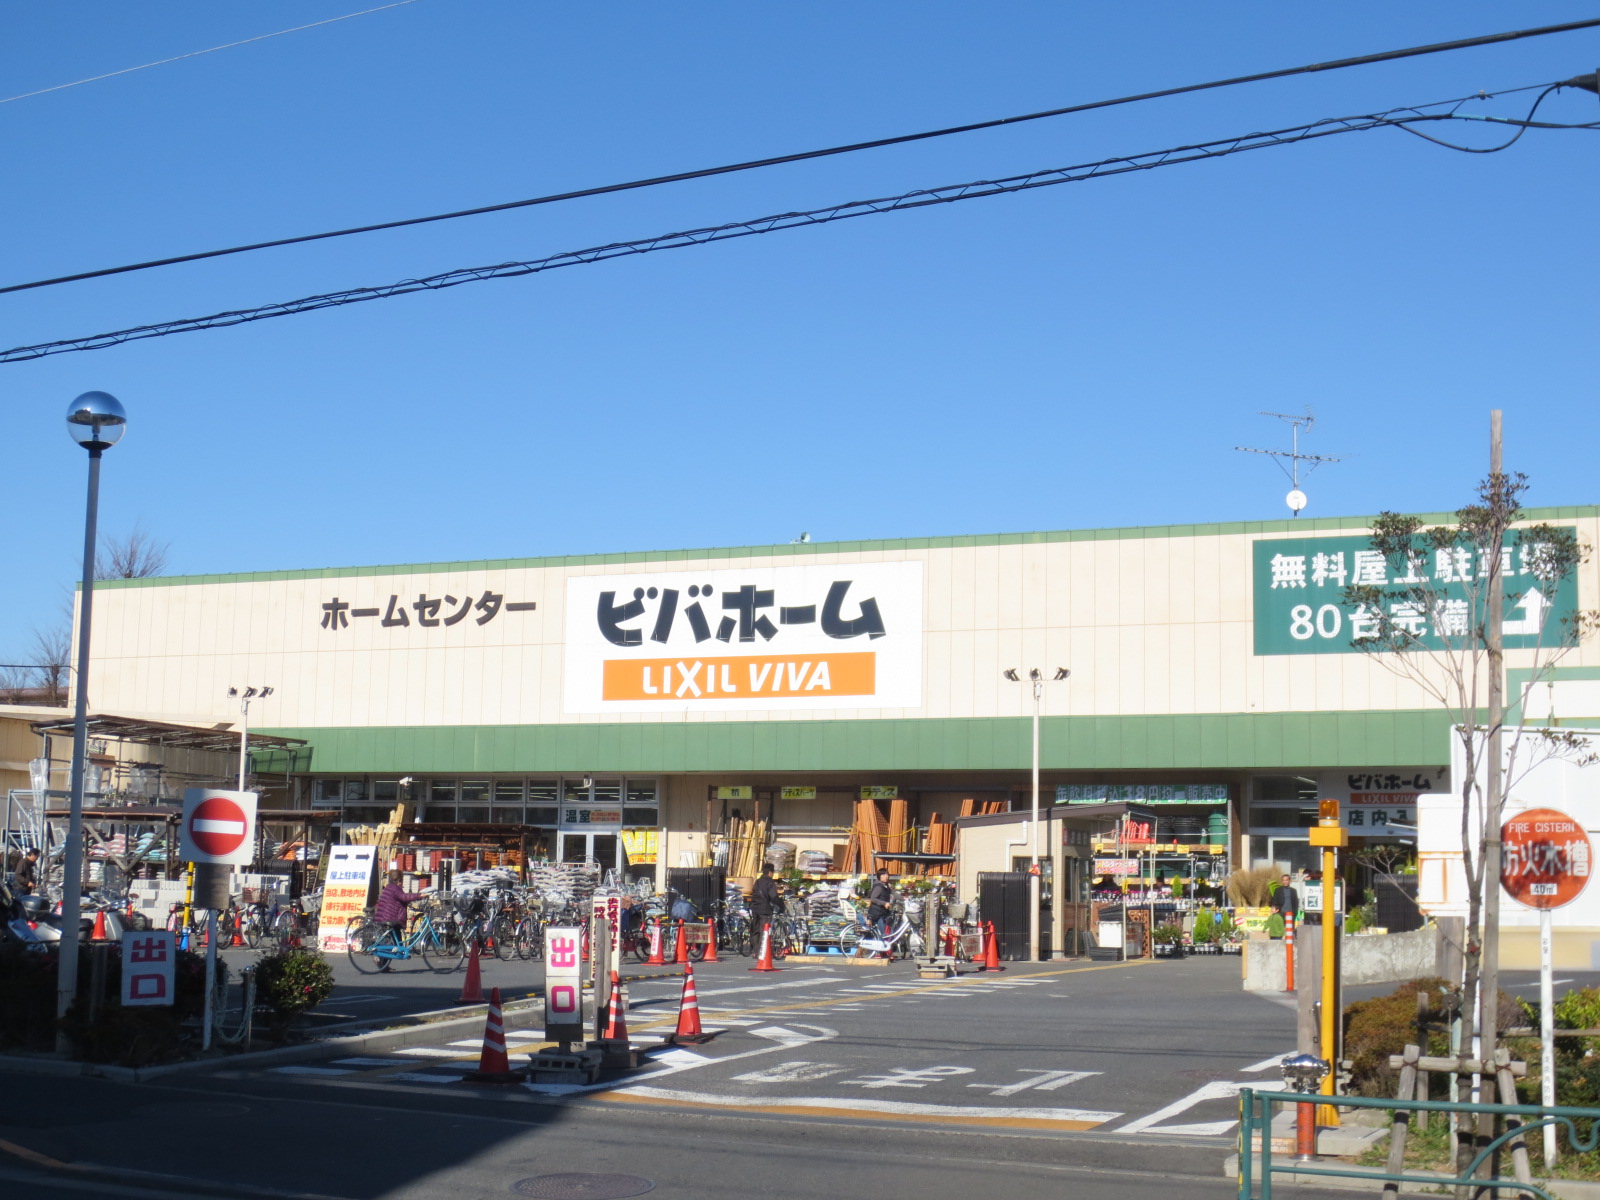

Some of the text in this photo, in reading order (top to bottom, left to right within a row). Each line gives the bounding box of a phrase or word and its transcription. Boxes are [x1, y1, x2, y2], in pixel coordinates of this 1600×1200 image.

[321, 590, 536, 631] ホームセンター
[597, 580, 886, 646] ビバホーム
[643, 661, 831, 698] LIXIL VIVA
[862, 788, 896, 797] ラティス
[1348, 774, 1432, 790] ビバホーム
[1362, 794, 1390, 804] LIXIL
[565, 809, 591, 823] 温室
[1508, 822, 1575, 833] FIRE CISTERN
[1500, 840, 1589, 877] 防火水槽
[330, 872, 366, 880] 屋上駐車場
[130, 938, 166, 1000] 出口
[551, 937, 575, 1013] 出口
